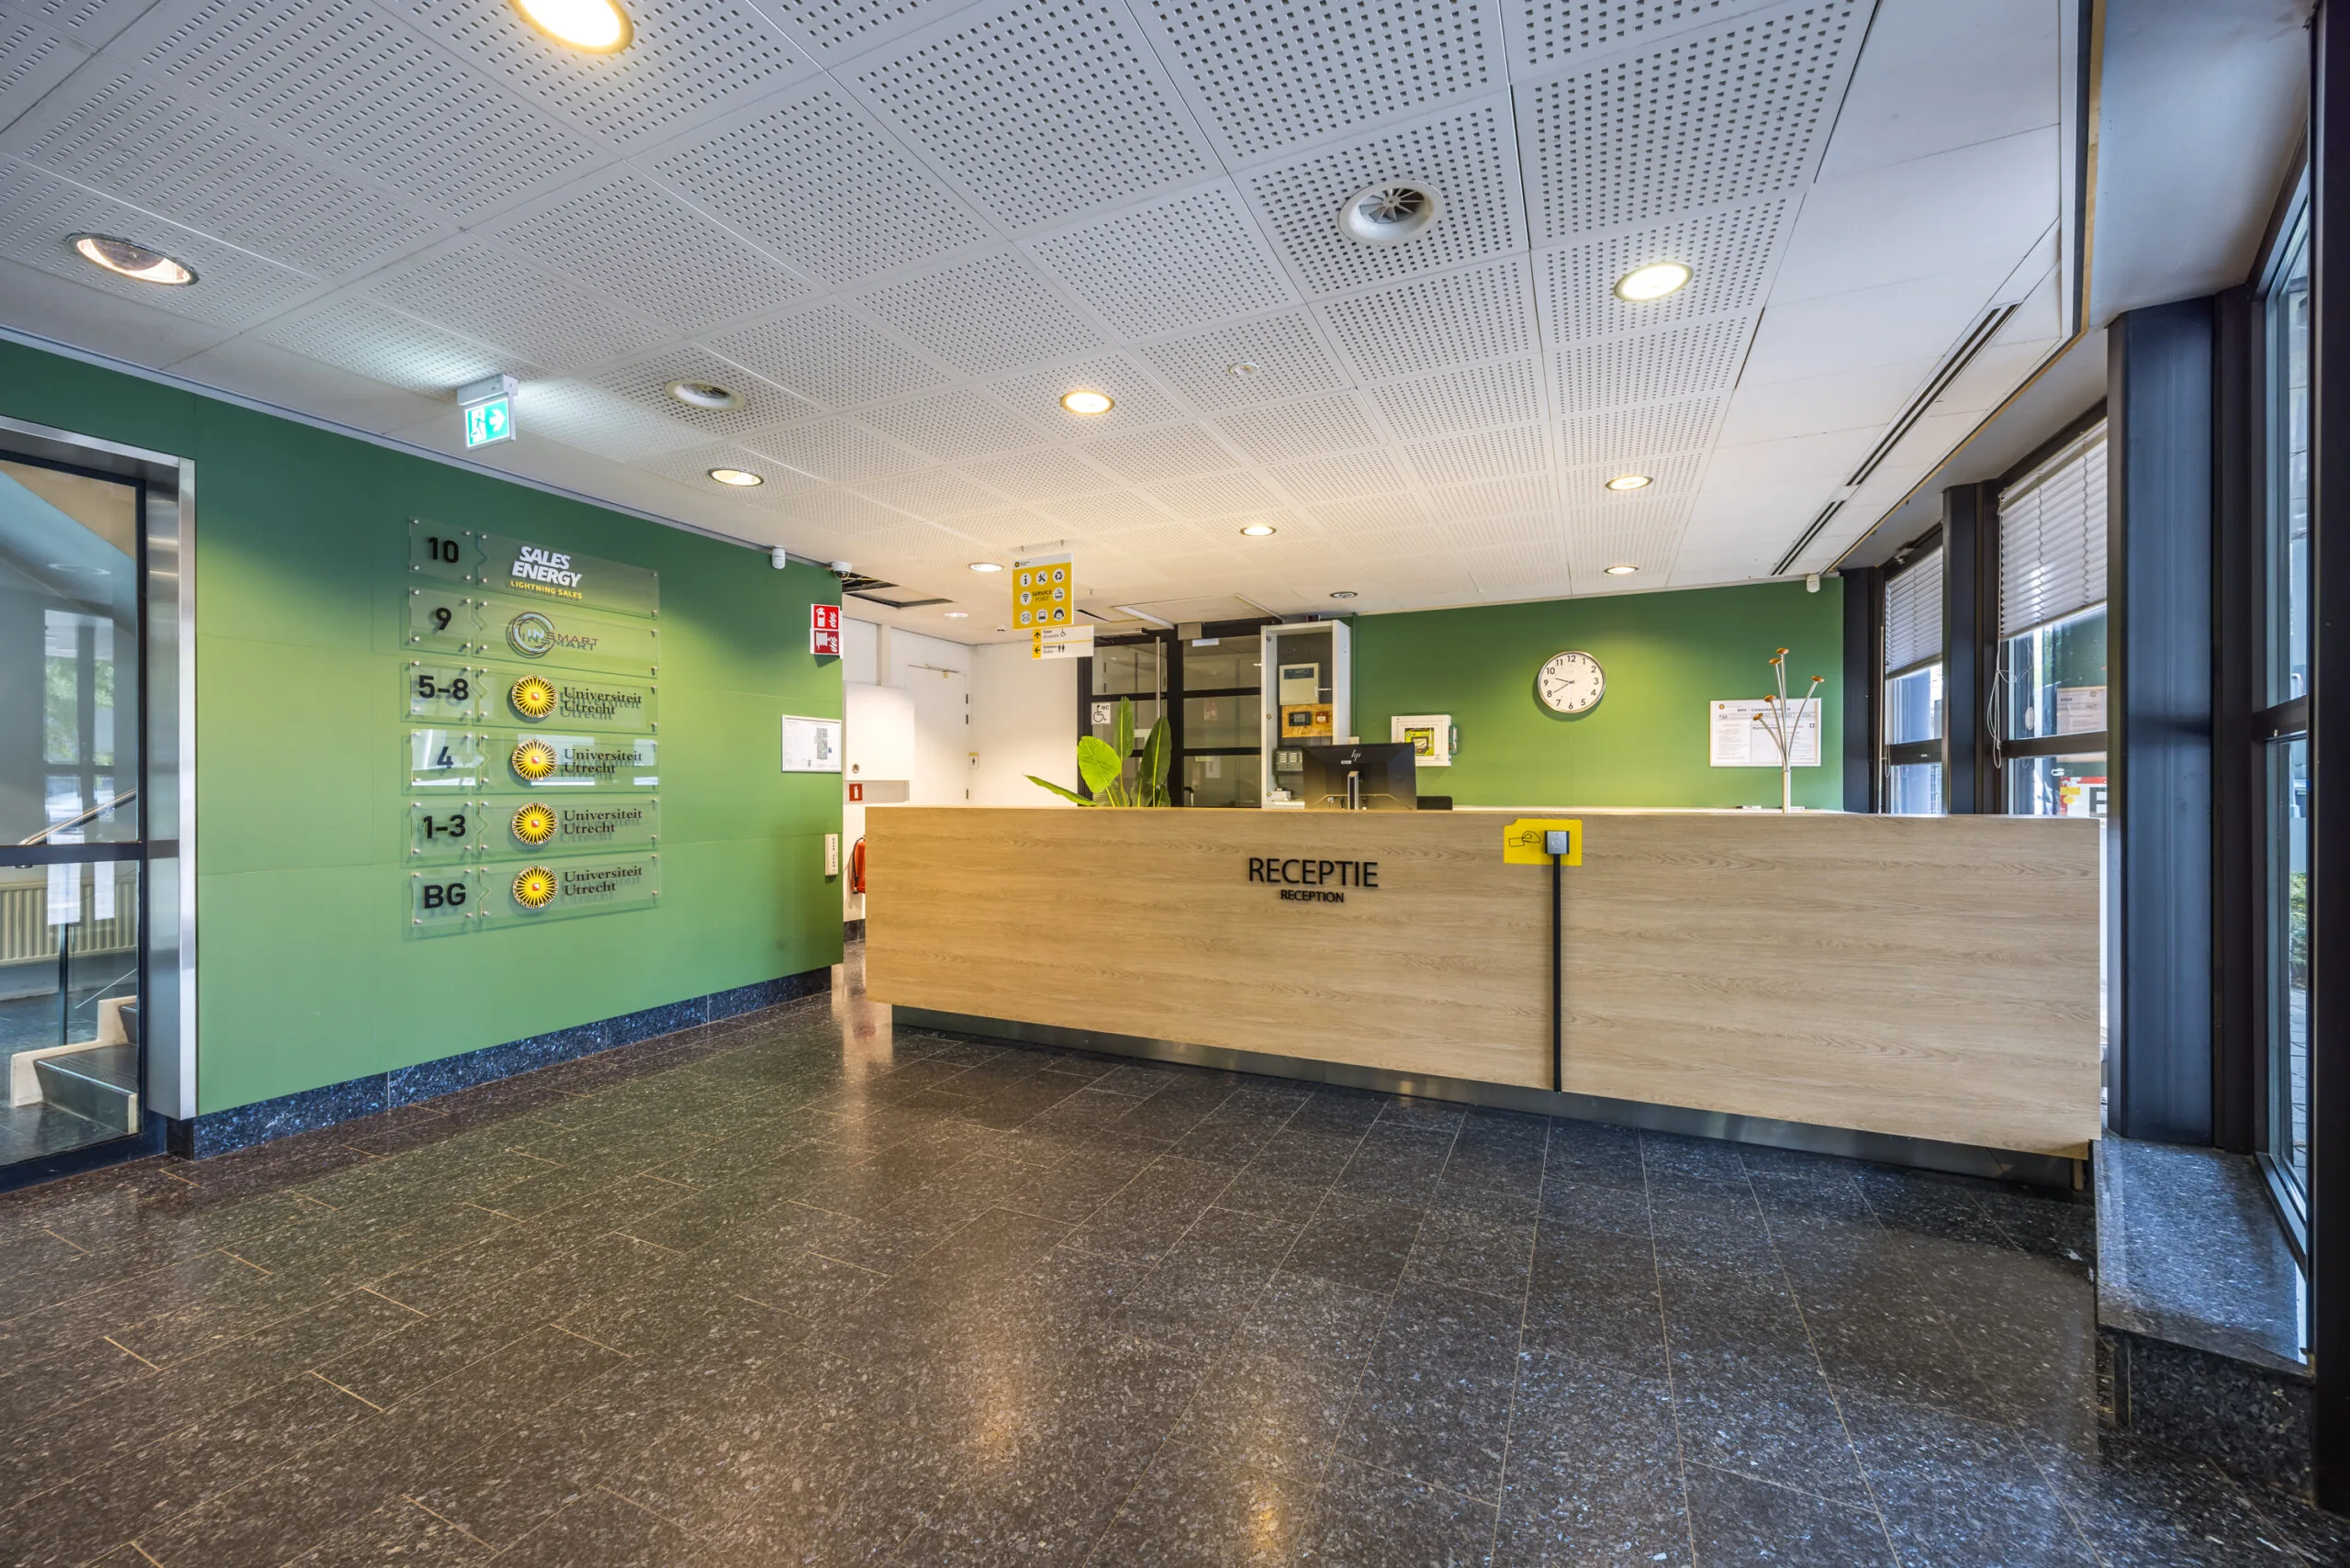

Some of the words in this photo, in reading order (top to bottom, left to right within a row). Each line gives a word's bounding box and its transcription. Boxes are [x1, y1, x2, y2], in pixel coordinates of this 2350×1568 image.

[428, 537, 459, 563] 10
[520, 545, 571, 569] SALES
[511, 561, 583, 588] ENERGY
[510, 580, 556, 594] LIGHTNING
[557, 588, 583, 599] SALES
[435, 607, 452, 631] 9
[419, 675, 469, 700] 5-8
[564, 687, 643, 704] Universiteit
[564, 700, 616, 714] Utrecht
[437, 746, 453, 769] 4
[564, 749, 643, 762] Universiteit
[1350, 748, 1361, 762] hp
[564, 763, 616, 774] Utrecht
[564, 808, 643, 822] Universiteit
[423, 814, 466, 839] 1-3
[564, 822, 616, 835] Utrecht
[564, 866, 643, 882] Universiteit
[1248, 857, 1379, 888] RECEPTIE
[423, 883, 466, 909] BG
[564, 881, 616, 896] Utrecht
[1280, 889, 1345, 903] RECEPTION
